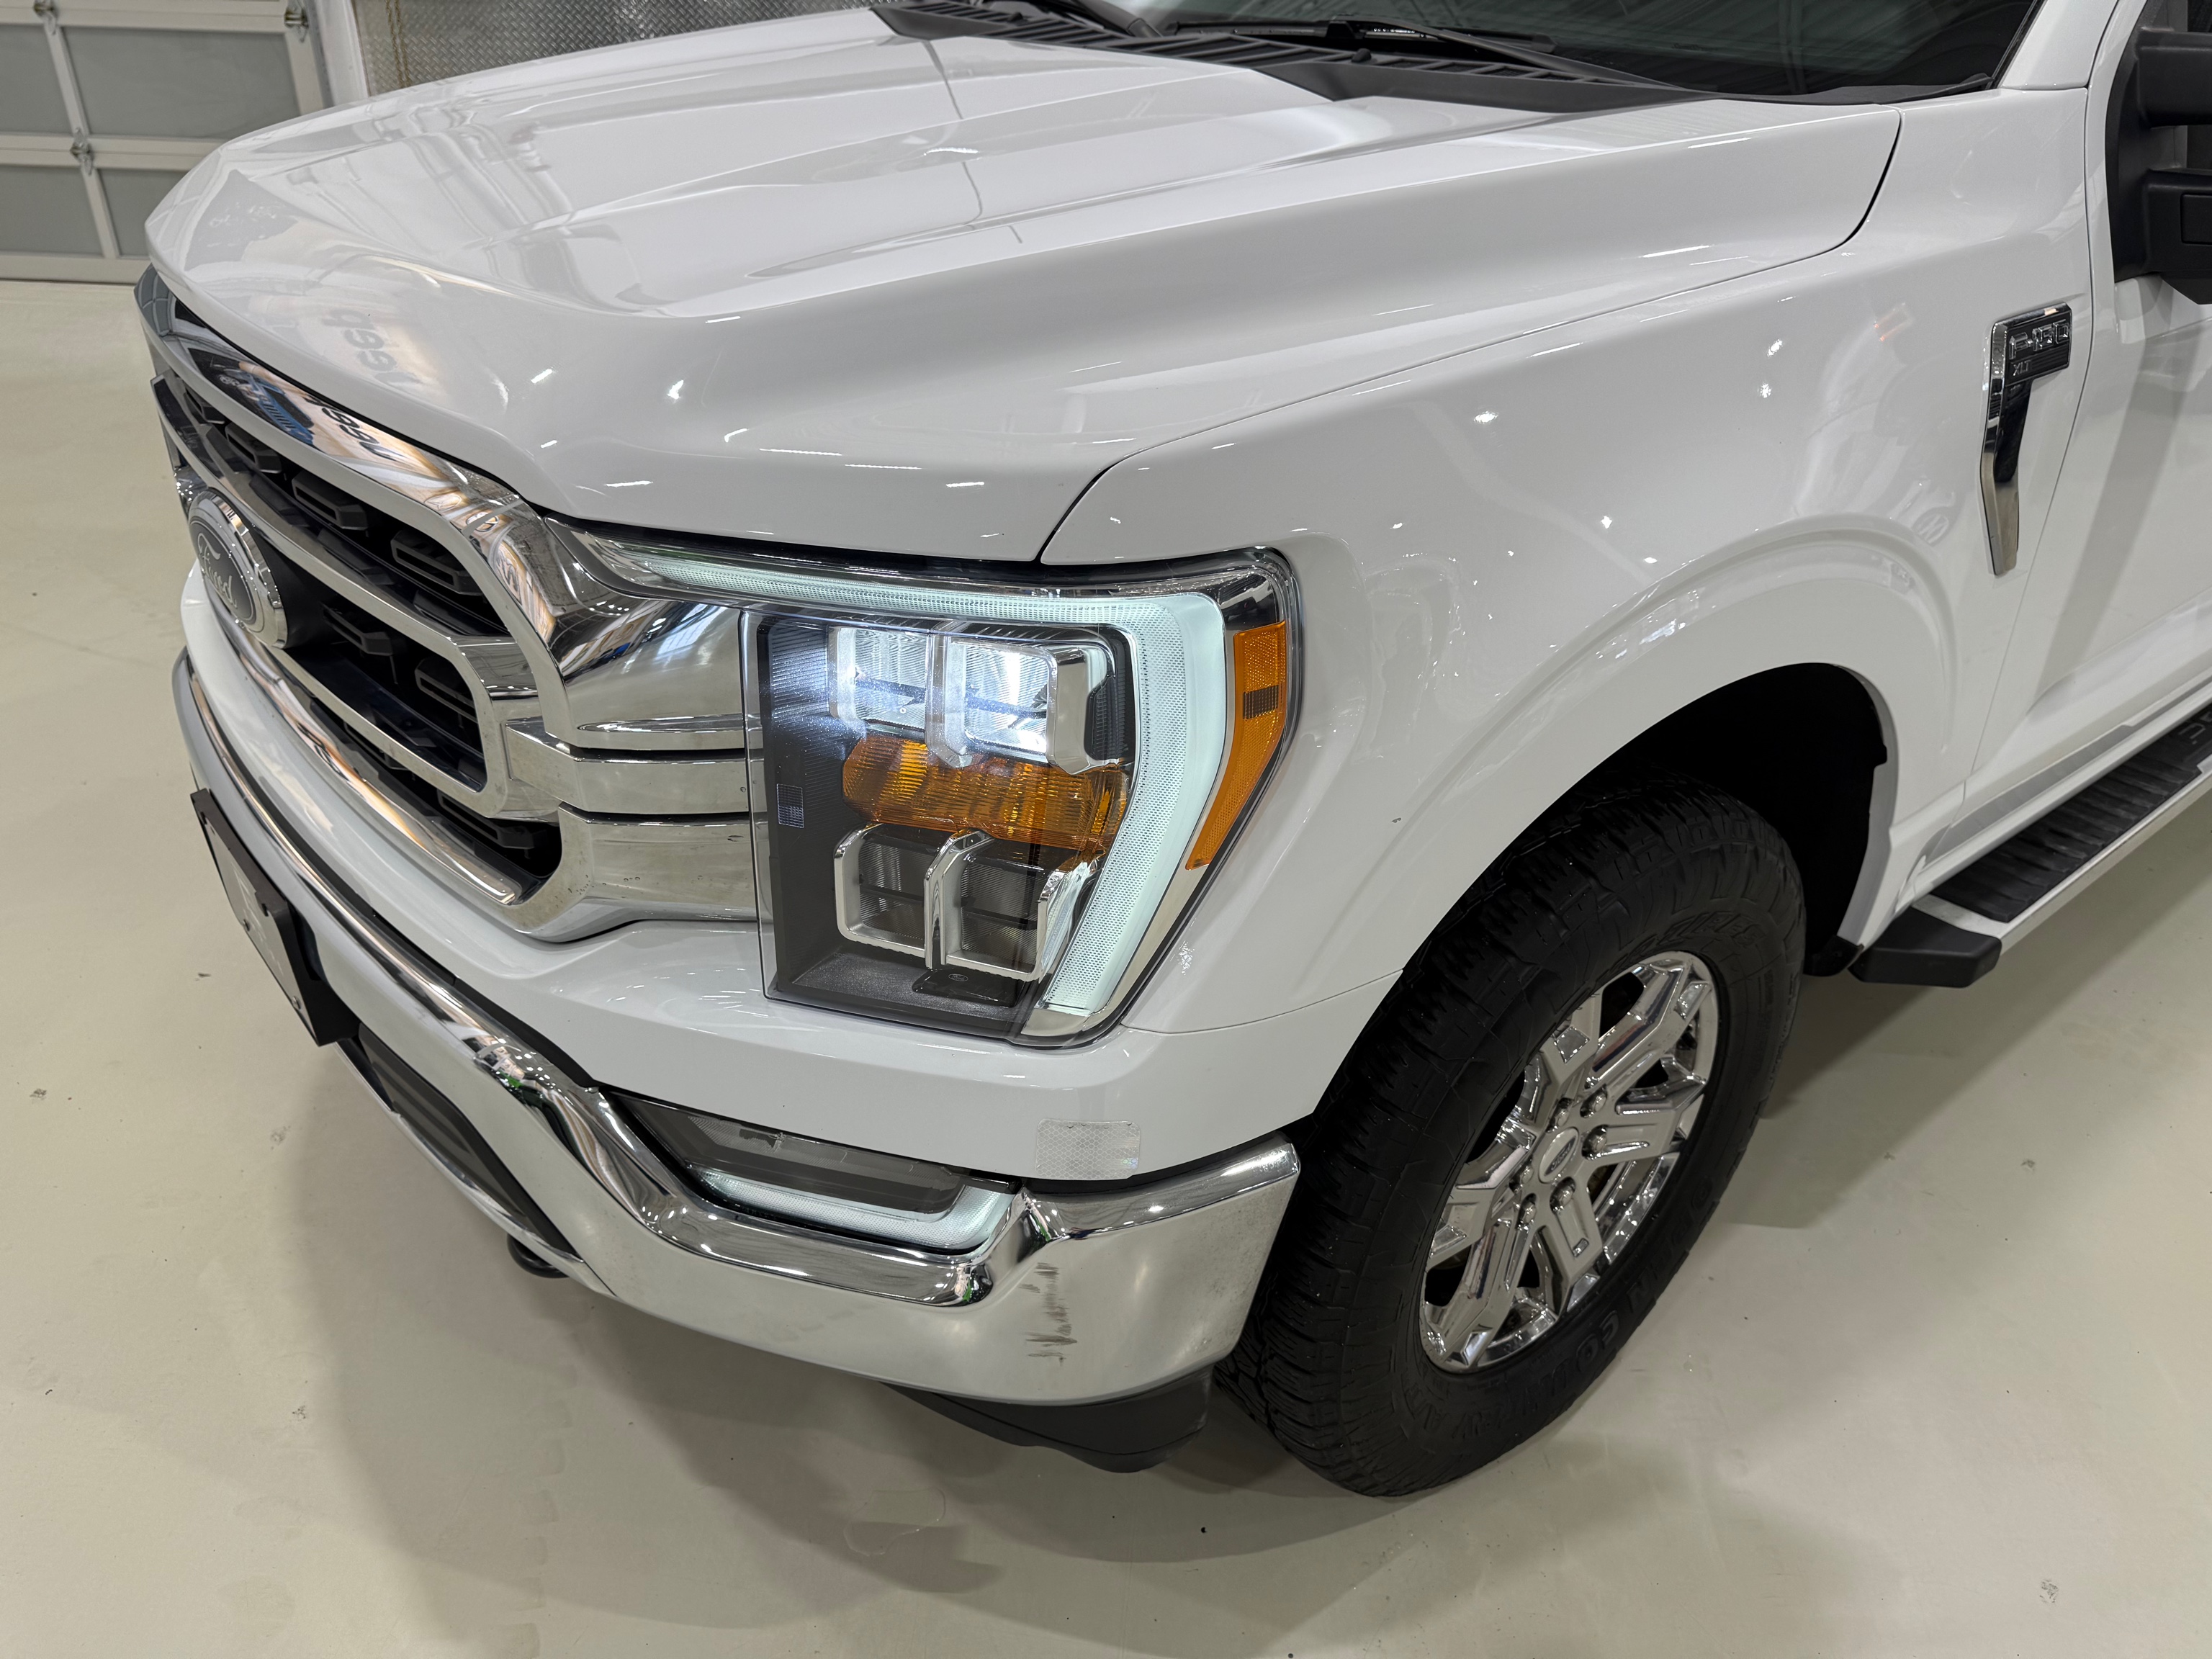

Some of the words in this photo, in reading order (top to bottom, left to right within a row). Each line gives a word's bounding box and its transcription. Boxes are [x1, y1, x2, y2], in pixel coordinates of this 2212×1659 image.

[2009, 319, 2070, 359] F-150
[2013, 360, 2031, 377] XLT
[197, 533, 238, 610] Ford
